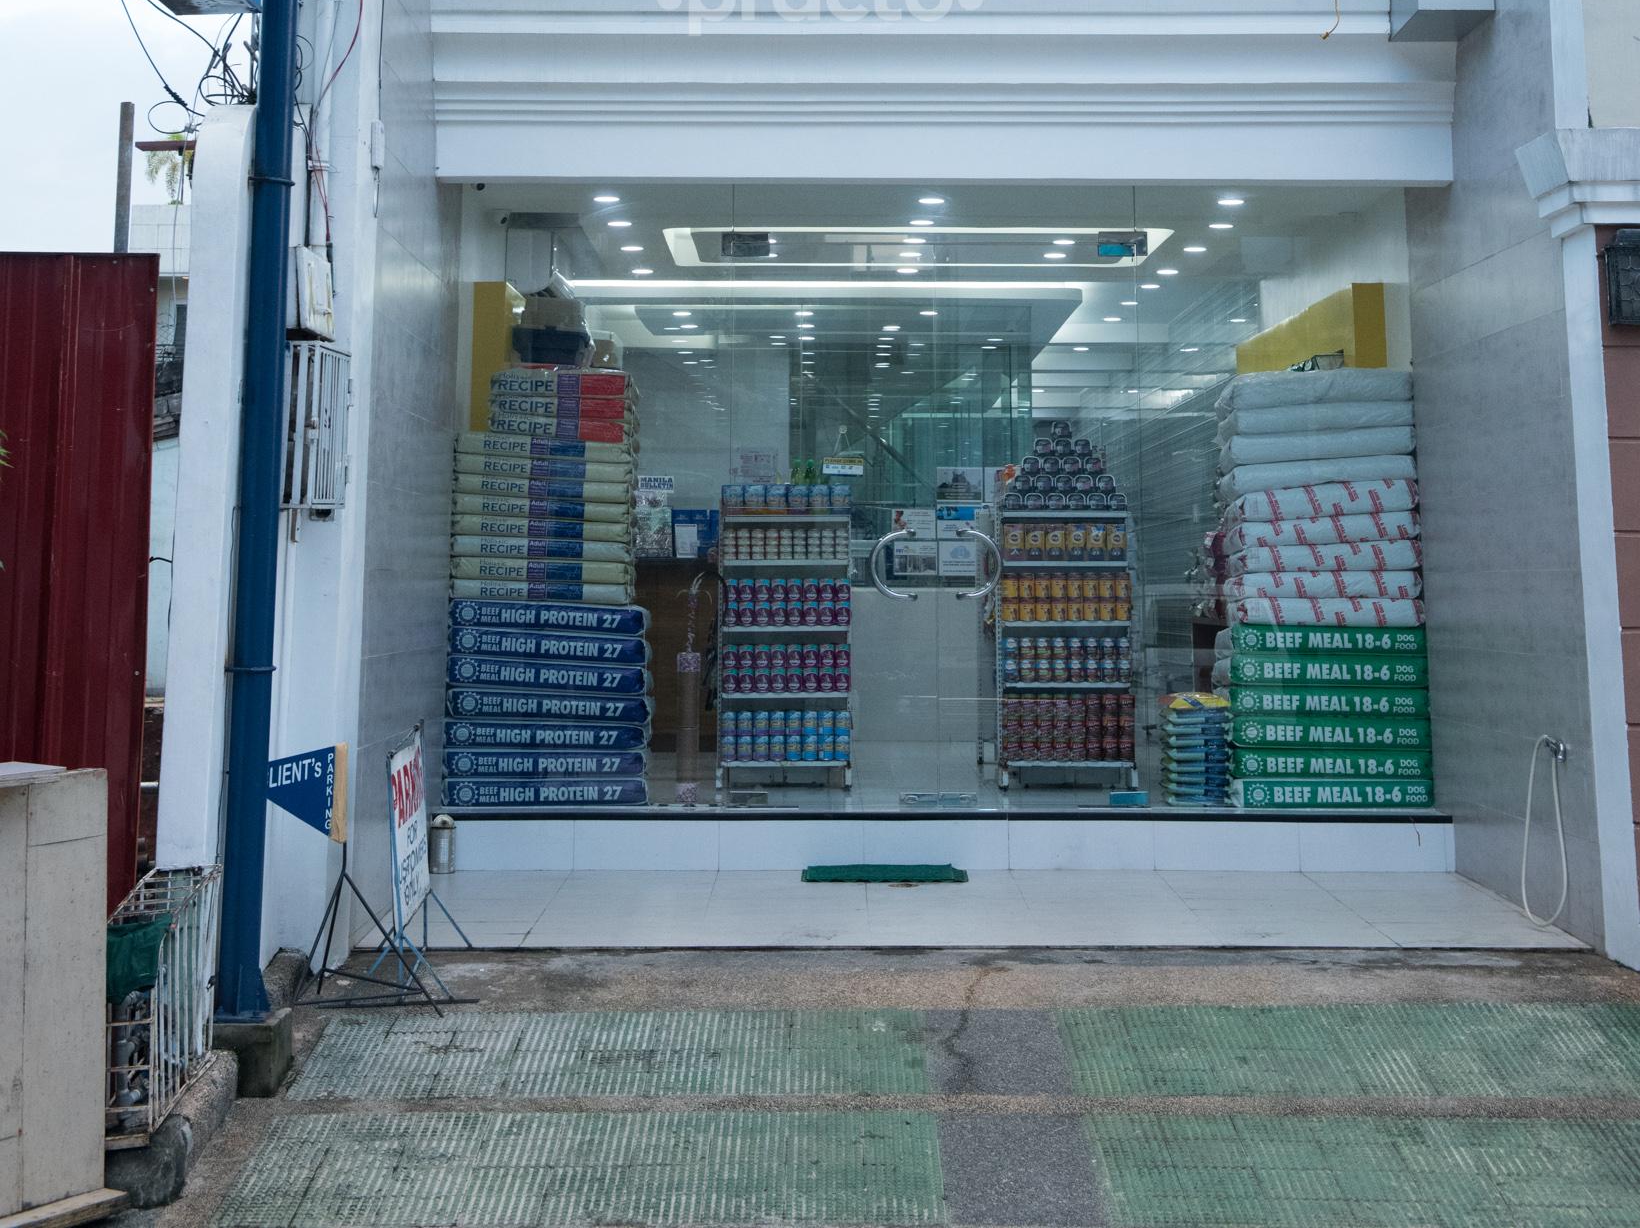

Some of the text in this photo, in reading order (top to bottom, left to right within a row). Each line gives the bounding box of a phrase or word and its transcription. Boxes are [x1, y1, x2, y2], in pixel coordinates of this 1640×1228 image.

[498, 379, 554, 392] RECIPE
[499, 399, 554, 414] RECIPE
[496, 419, 553, 435] RECIPE
[483, 439, 528, 452] RECIPE
[483, 460, 528, 473] RECIPE
[481, 480, 526, 493] RECIPE
[482, 502, 527, 513] RECIPE
[480, 522, 526, 534] RECIPE
[480, 543, 525, 554] RECIPE
[479, 565, 524, 577] RECIPE
[480, 587, 525, 597] RECIPE
[481, 615, 499, 623] MEAL
[501, 609, 621, 628] HIGH PROTEIN 27
[481, 635, 500, 643] BEEF
[1266, 632, 1391, 649] BEEF MEAL 18-6
[1397, 634, 1415, 642] DOG
[481, 643, 500, 651] MEAL
[501, 637, 623, 658] HIGH PROTEIN 27
[1395, 642, 1417, 650] FOOD
[481, 664, 499, 672] BEEF
[1264, 663, 1390, 680] BEEF MEAL 18-6
[1396, 665, 1413, 673] DOG
[480, 672, 499, 680] MEAL
[501, 666, 621, 687] HIGH PROTEIN 27
[1394, 674, 1416, 682] FOOD
[483, 697, 501, 705] BEEF
[1262, 695, 1389, 712] BEEF MEAL 18-6
[1395, 697, 1413, 705] DOG
[483, 705, 500, 713] MEAL
[503, 698, 625, 716] HIGH PROTEIN 27
[1393, 706, 1415, 714] FOOD
[497, 729, 618, 745] HIGH PROTEIN 27
[1266, 725, 1393, 744] BEEF MEAL 18-6
[1399, 729, 1417, 737] DOG
[476, 735, 494, 743] MEAL
[1397, 737, 1419, 745] FOOD
[478, 757, 497, 765] BEEF
[499, 758, 620, 772] HIGH PROTEIN 27
[1267, 757, 1394, 774] BEEF MEAL 18-6
[268, 758, 322, 788] LIENT's
[1398, 768, 1421, 776] FOOD
[325, 753, 334, 830] PARKING
[479, 786, 498, 794] BEEF
[500, 786, 623, 802] HIGH PROTEIN 27
[1274, 786, 1401, 803] BEEF MEAL 18-6
[479, 795, 498, 803] MEAL
[1406, 795, 1428, 803] FOOD
